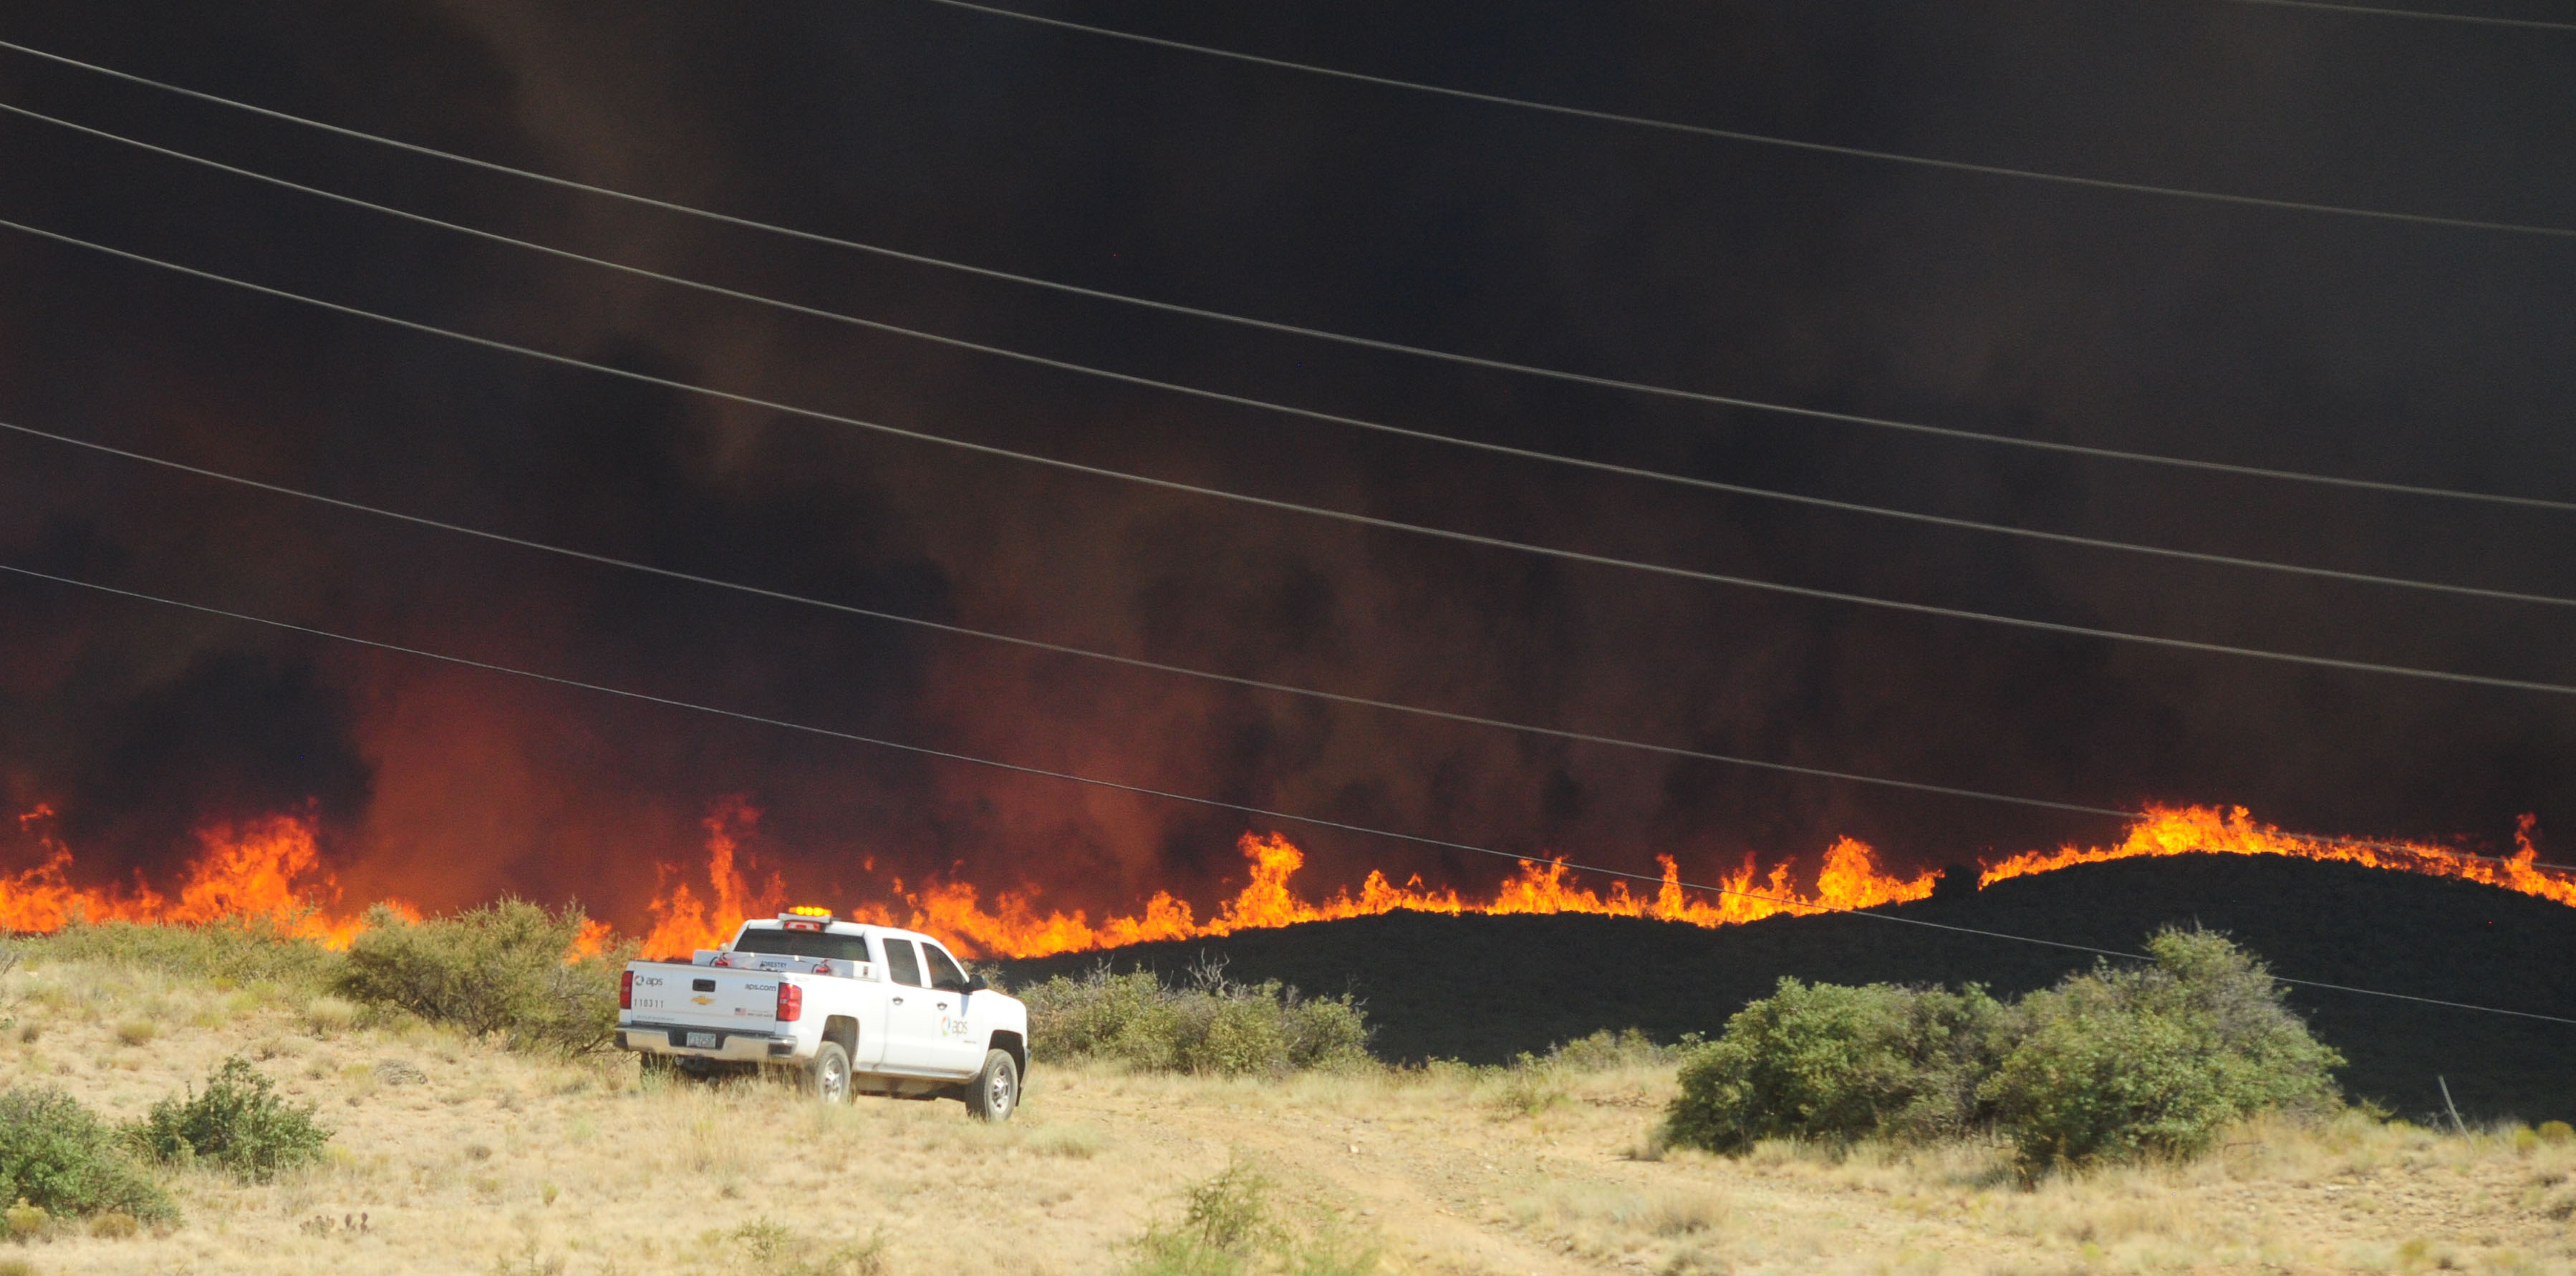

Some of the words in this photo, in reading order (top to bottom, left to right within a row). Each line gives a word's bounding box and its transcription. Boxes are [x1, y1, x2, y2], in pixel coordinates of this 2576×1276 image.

[646, 977, 663, 987] aps
[635, 999, 663, 1008] 110311
[952, 1020, 968, 1037] aps
